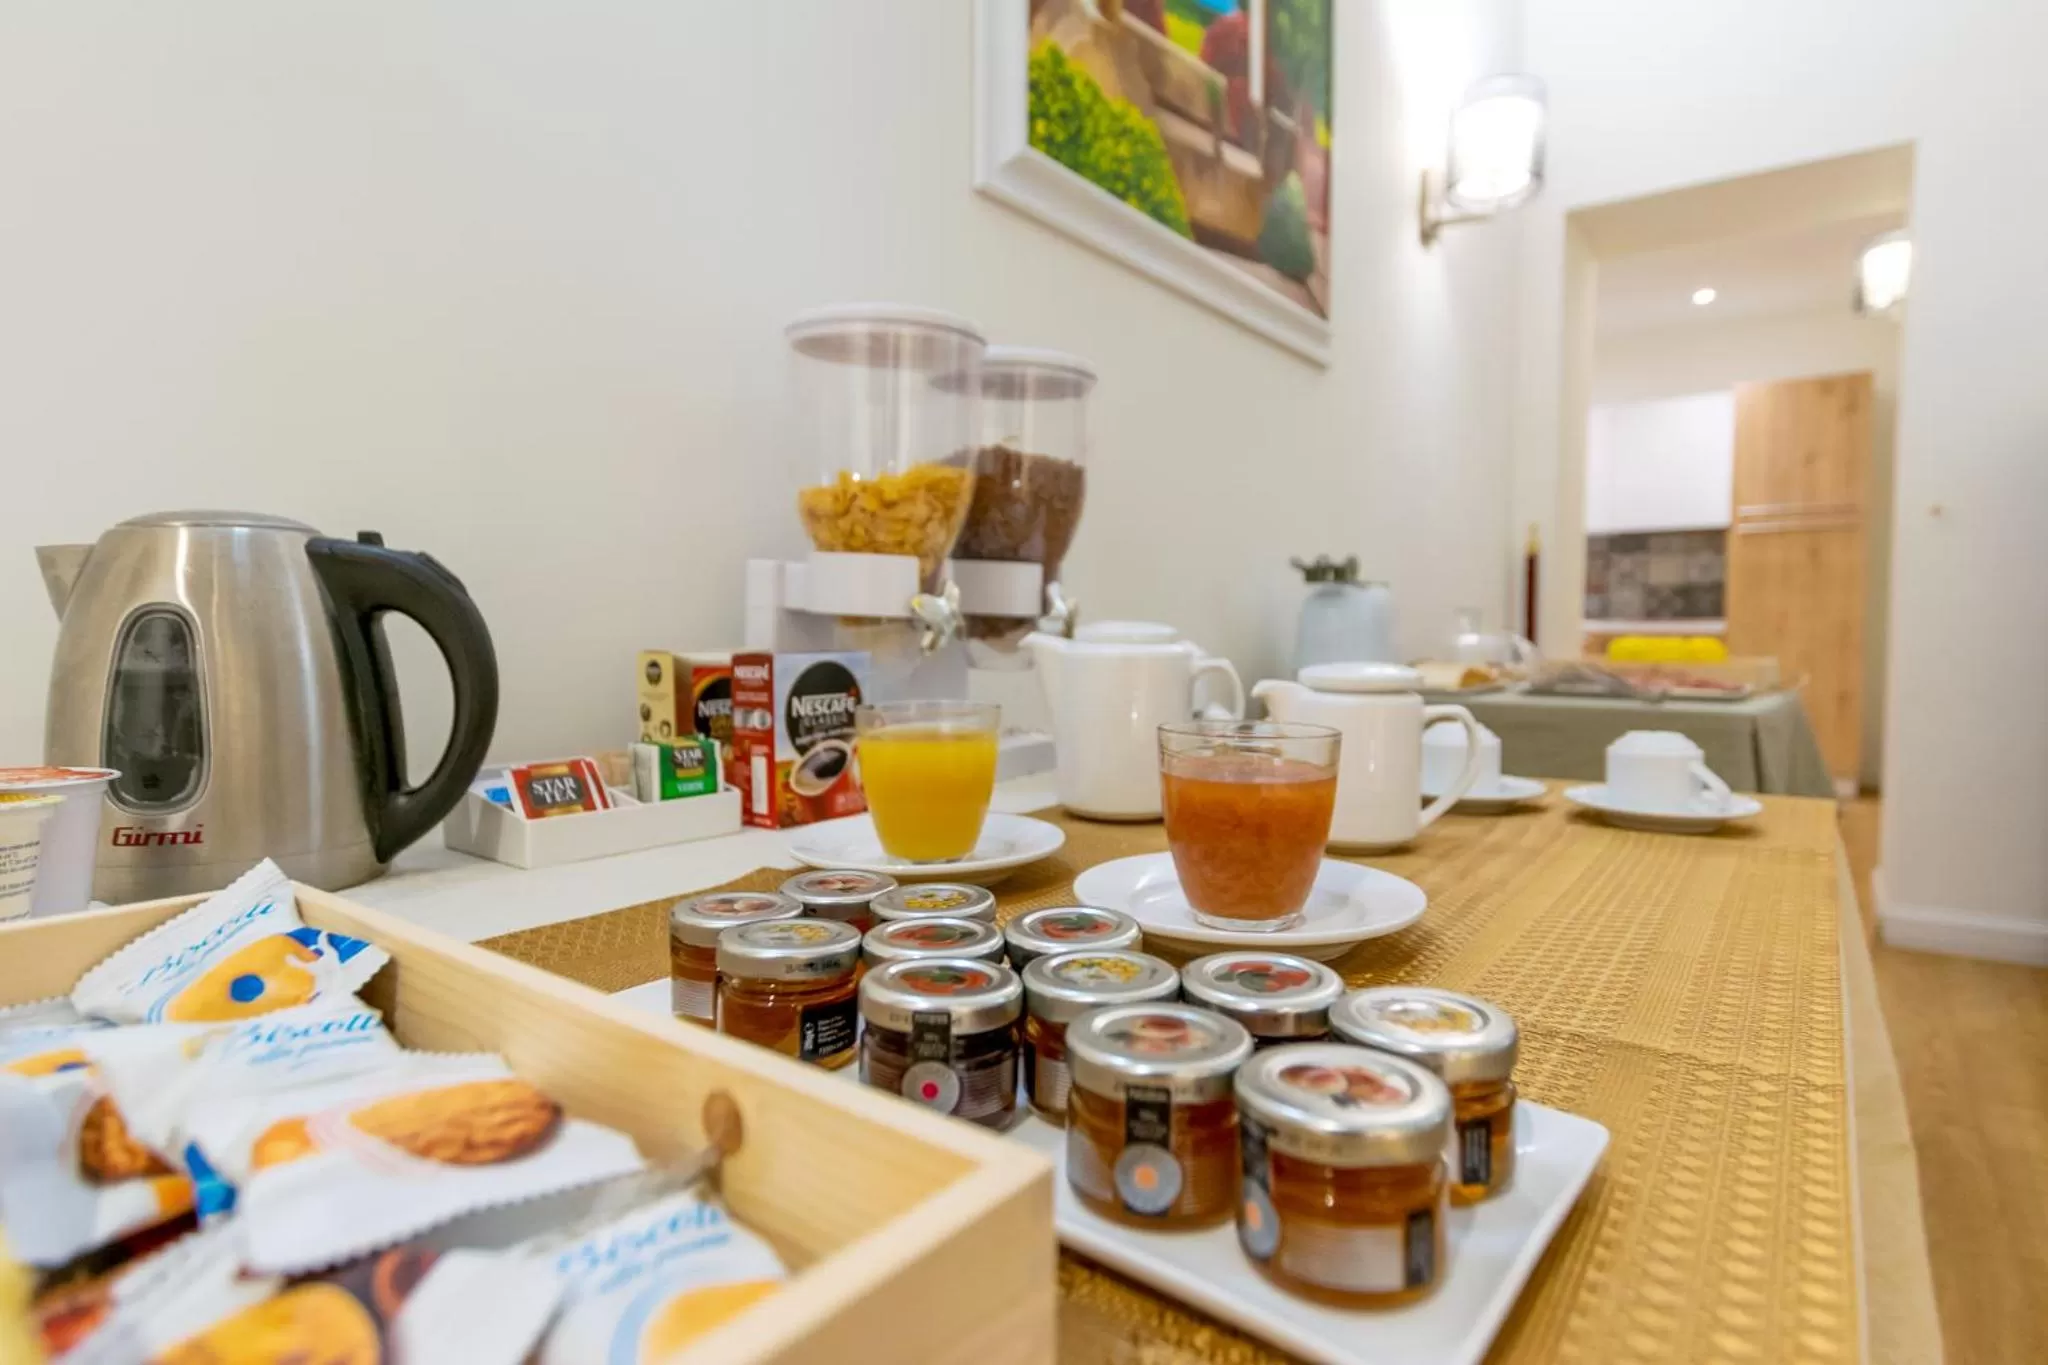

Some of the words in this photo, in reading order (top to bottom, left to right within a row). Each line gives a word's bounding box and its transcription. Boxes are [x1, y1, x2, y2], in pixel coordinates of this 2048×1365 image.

[531, 776, 577, 797] STAR
[543, 788, 577, 804] TEA
[112, 824, 204, 847] Girmi
